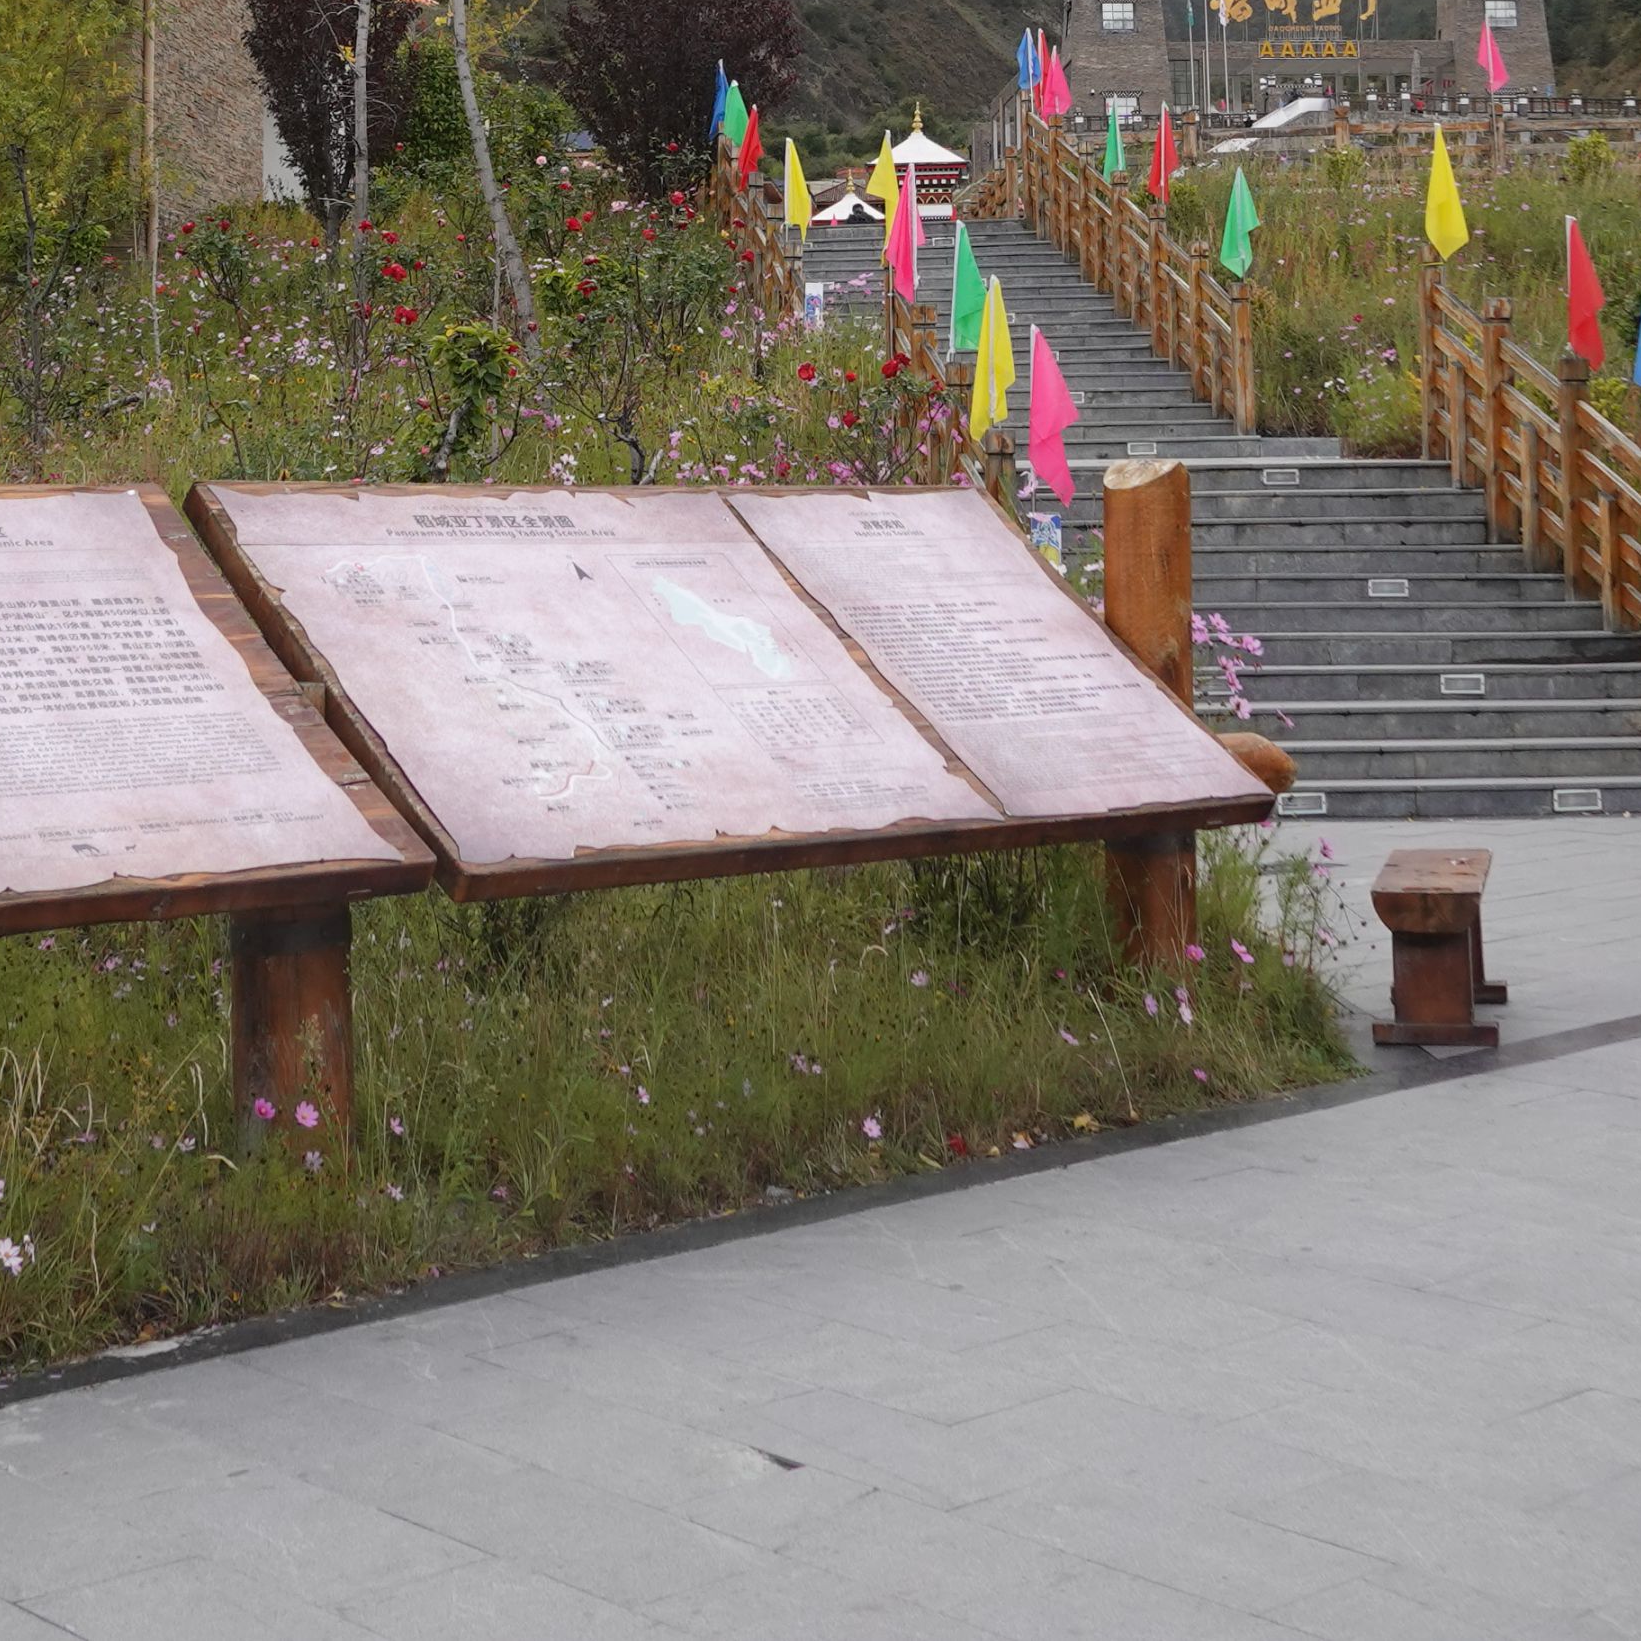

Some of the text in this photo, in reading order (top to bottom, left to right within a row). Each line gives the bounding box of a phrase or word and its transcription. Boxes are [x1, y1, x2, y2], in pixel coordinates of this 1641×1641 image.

[1268, 24, 1342, 32] DAOCHENG YADING
[413, 514, 575, 528] 稻城亚丁景区全景图
[386, 528, 616, 538] Panorama of Daocheng Yading Scenic Area
[25, 538, 54, 547] Area
